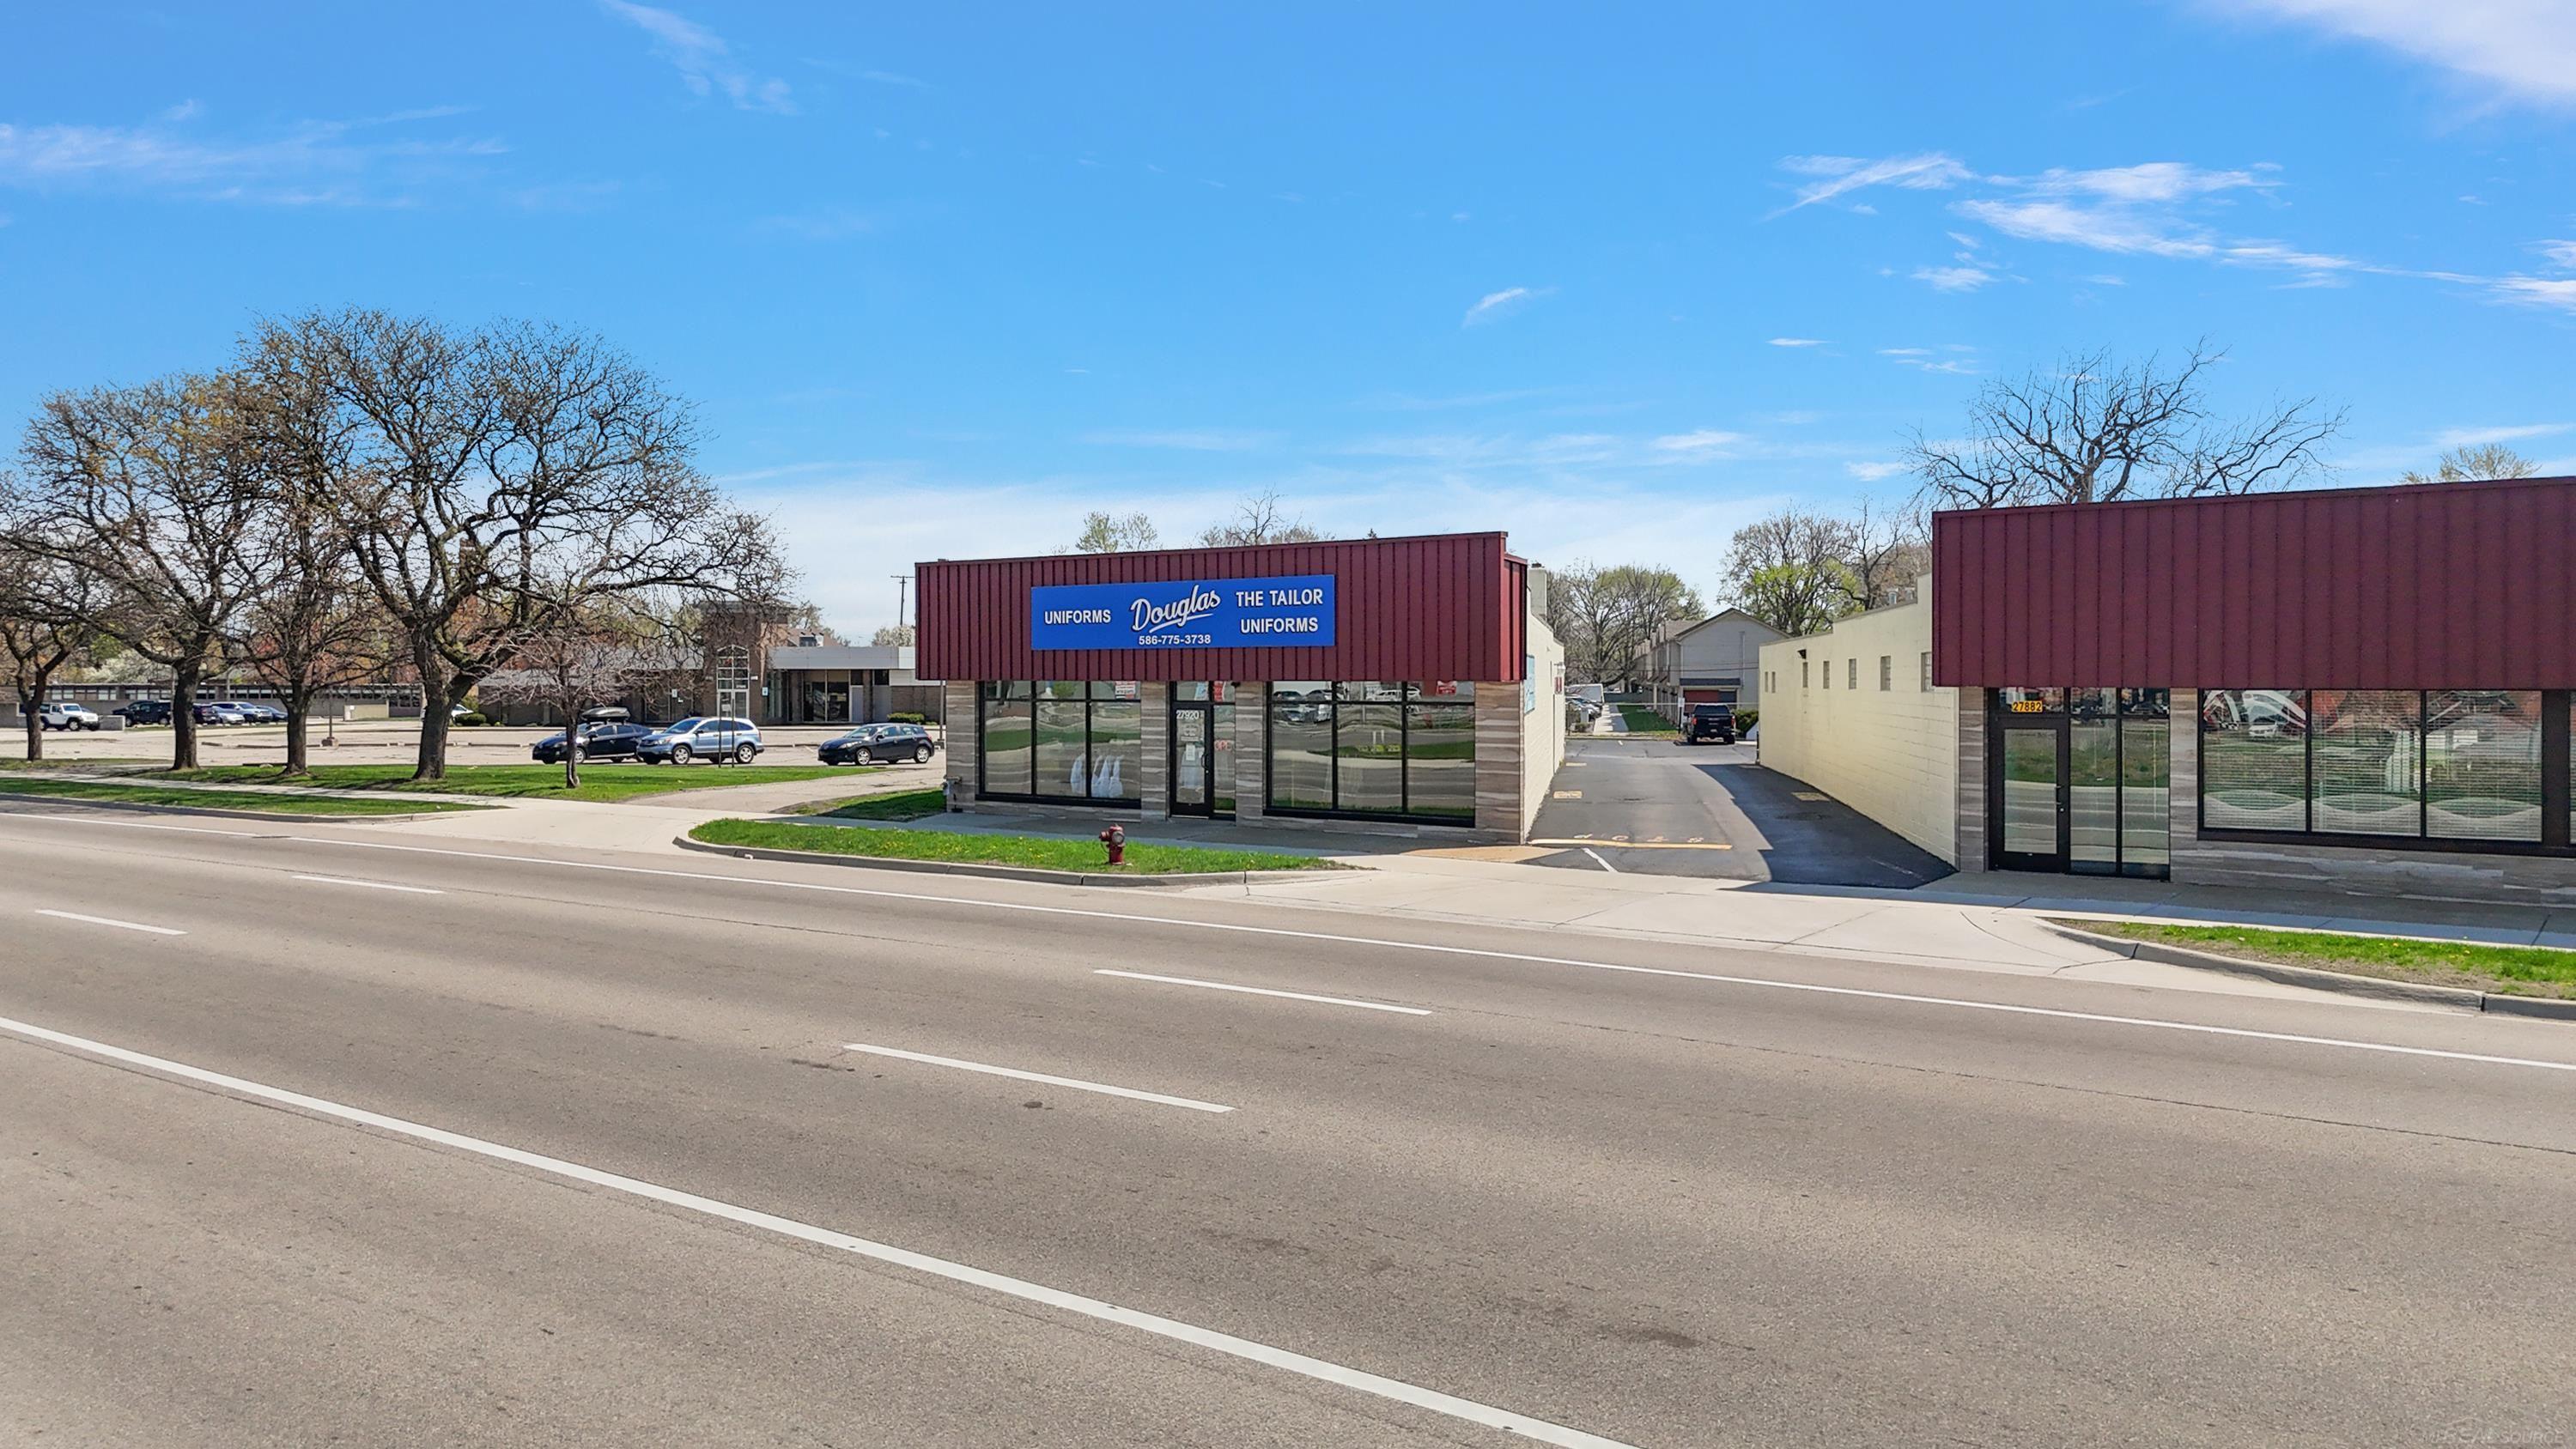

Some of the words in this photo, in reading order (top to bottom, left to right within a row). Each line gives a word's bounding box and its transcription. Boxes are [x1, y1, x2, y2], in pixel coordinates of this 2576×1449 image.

[1236, 591, 1264, 607] THE
[1269, 588, 1323, 606] TAILOR
[1130, 585, 1221, 631] Douglas
[1044, 609, 1111, 625] UNIFORMS
[1241, 617, 1319, 634] UNIFORMS
[1139, 634, 1212, 645] 586-775-3738
[1176, 709, 1200, 720] 27920
[2013, 701, 2042, 712] 27882
